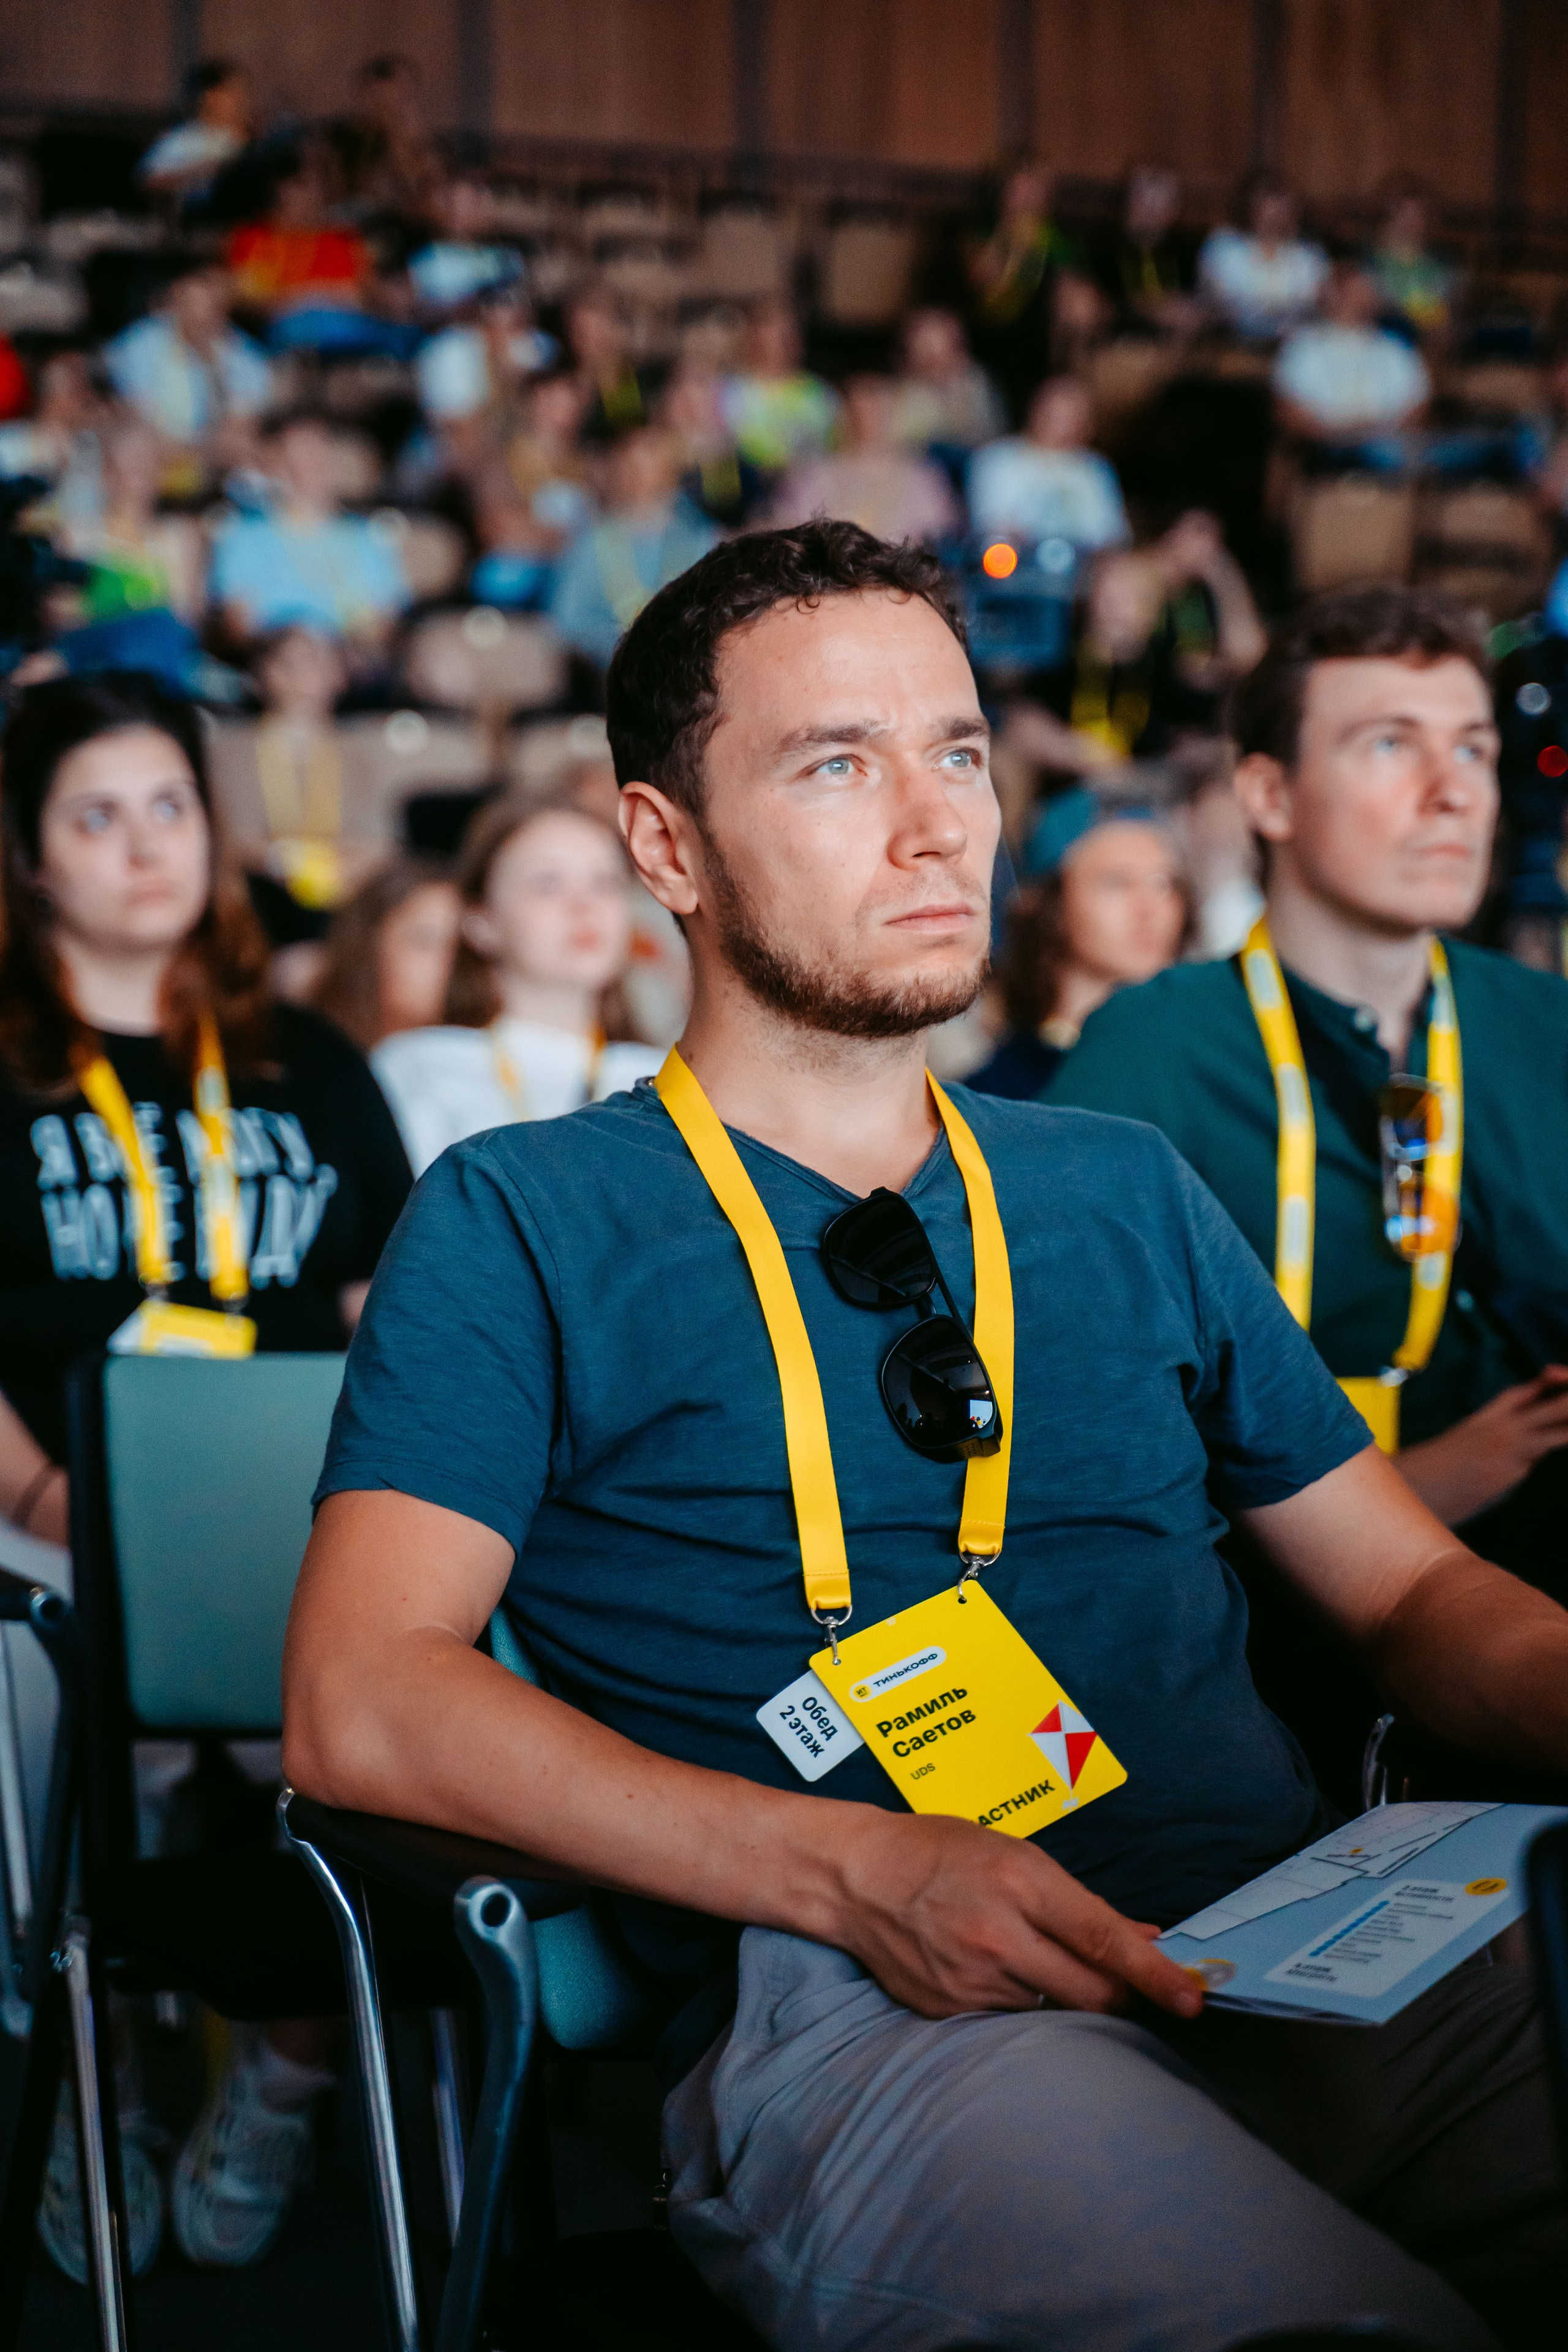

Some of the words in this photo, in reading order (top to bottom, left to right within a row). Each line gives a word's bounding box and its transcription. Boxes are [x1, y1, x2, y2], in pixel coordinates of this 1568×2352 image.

[873, 1653, 938, 1687] ТИНЬКОФФ
[779, 1705, 795, 1720] 2
[788, 1717, 825, 1758] этаж
[802, 1697, 838, 1741] Обед
[876, 1688, 968, 1738] Рамиль
[892, 1709, 976, 1757] Саетов
[910, 1763, 936, 1780] UDS
[978, 1778, 1056, 1826] АСТНИК
